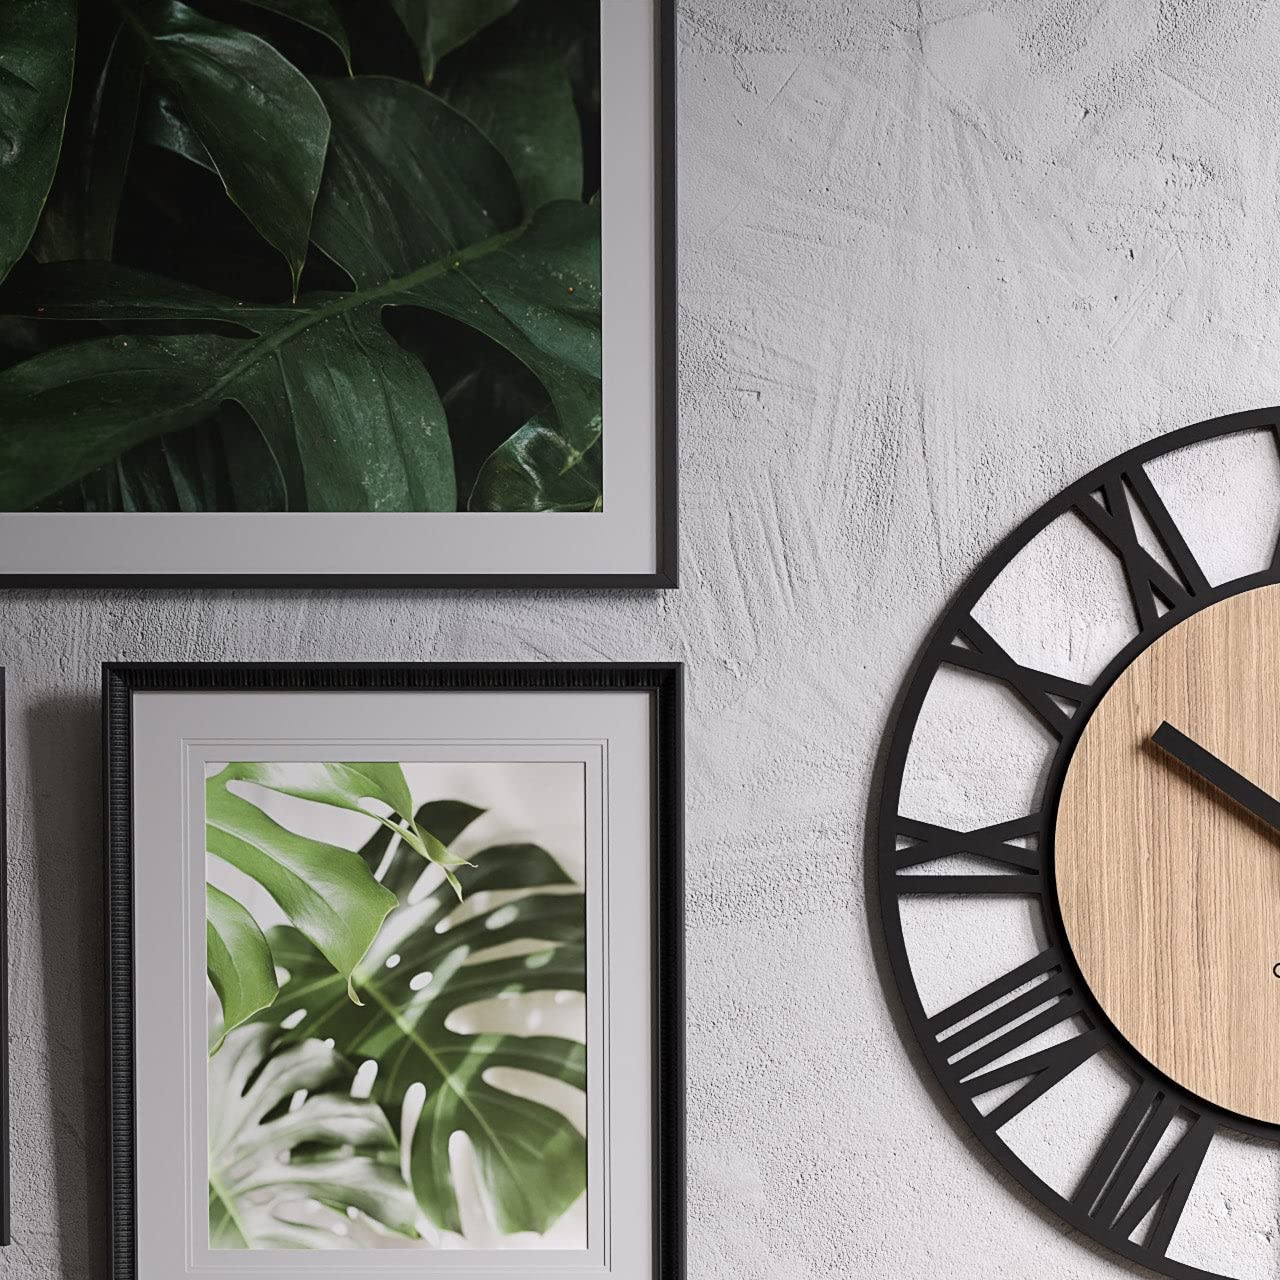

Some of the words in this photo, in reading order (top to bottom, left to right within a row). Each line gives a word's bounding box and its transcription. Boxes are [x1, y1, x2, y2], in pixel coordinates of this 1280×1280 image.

[1075, 463, 1213, 633] XI
[941, 614, 1093, 742] X
[896, 815, 1044, 895] IX
[928, 948, 1107, 1132] VIII
[1070, 1082, 1215, 1257] VII
